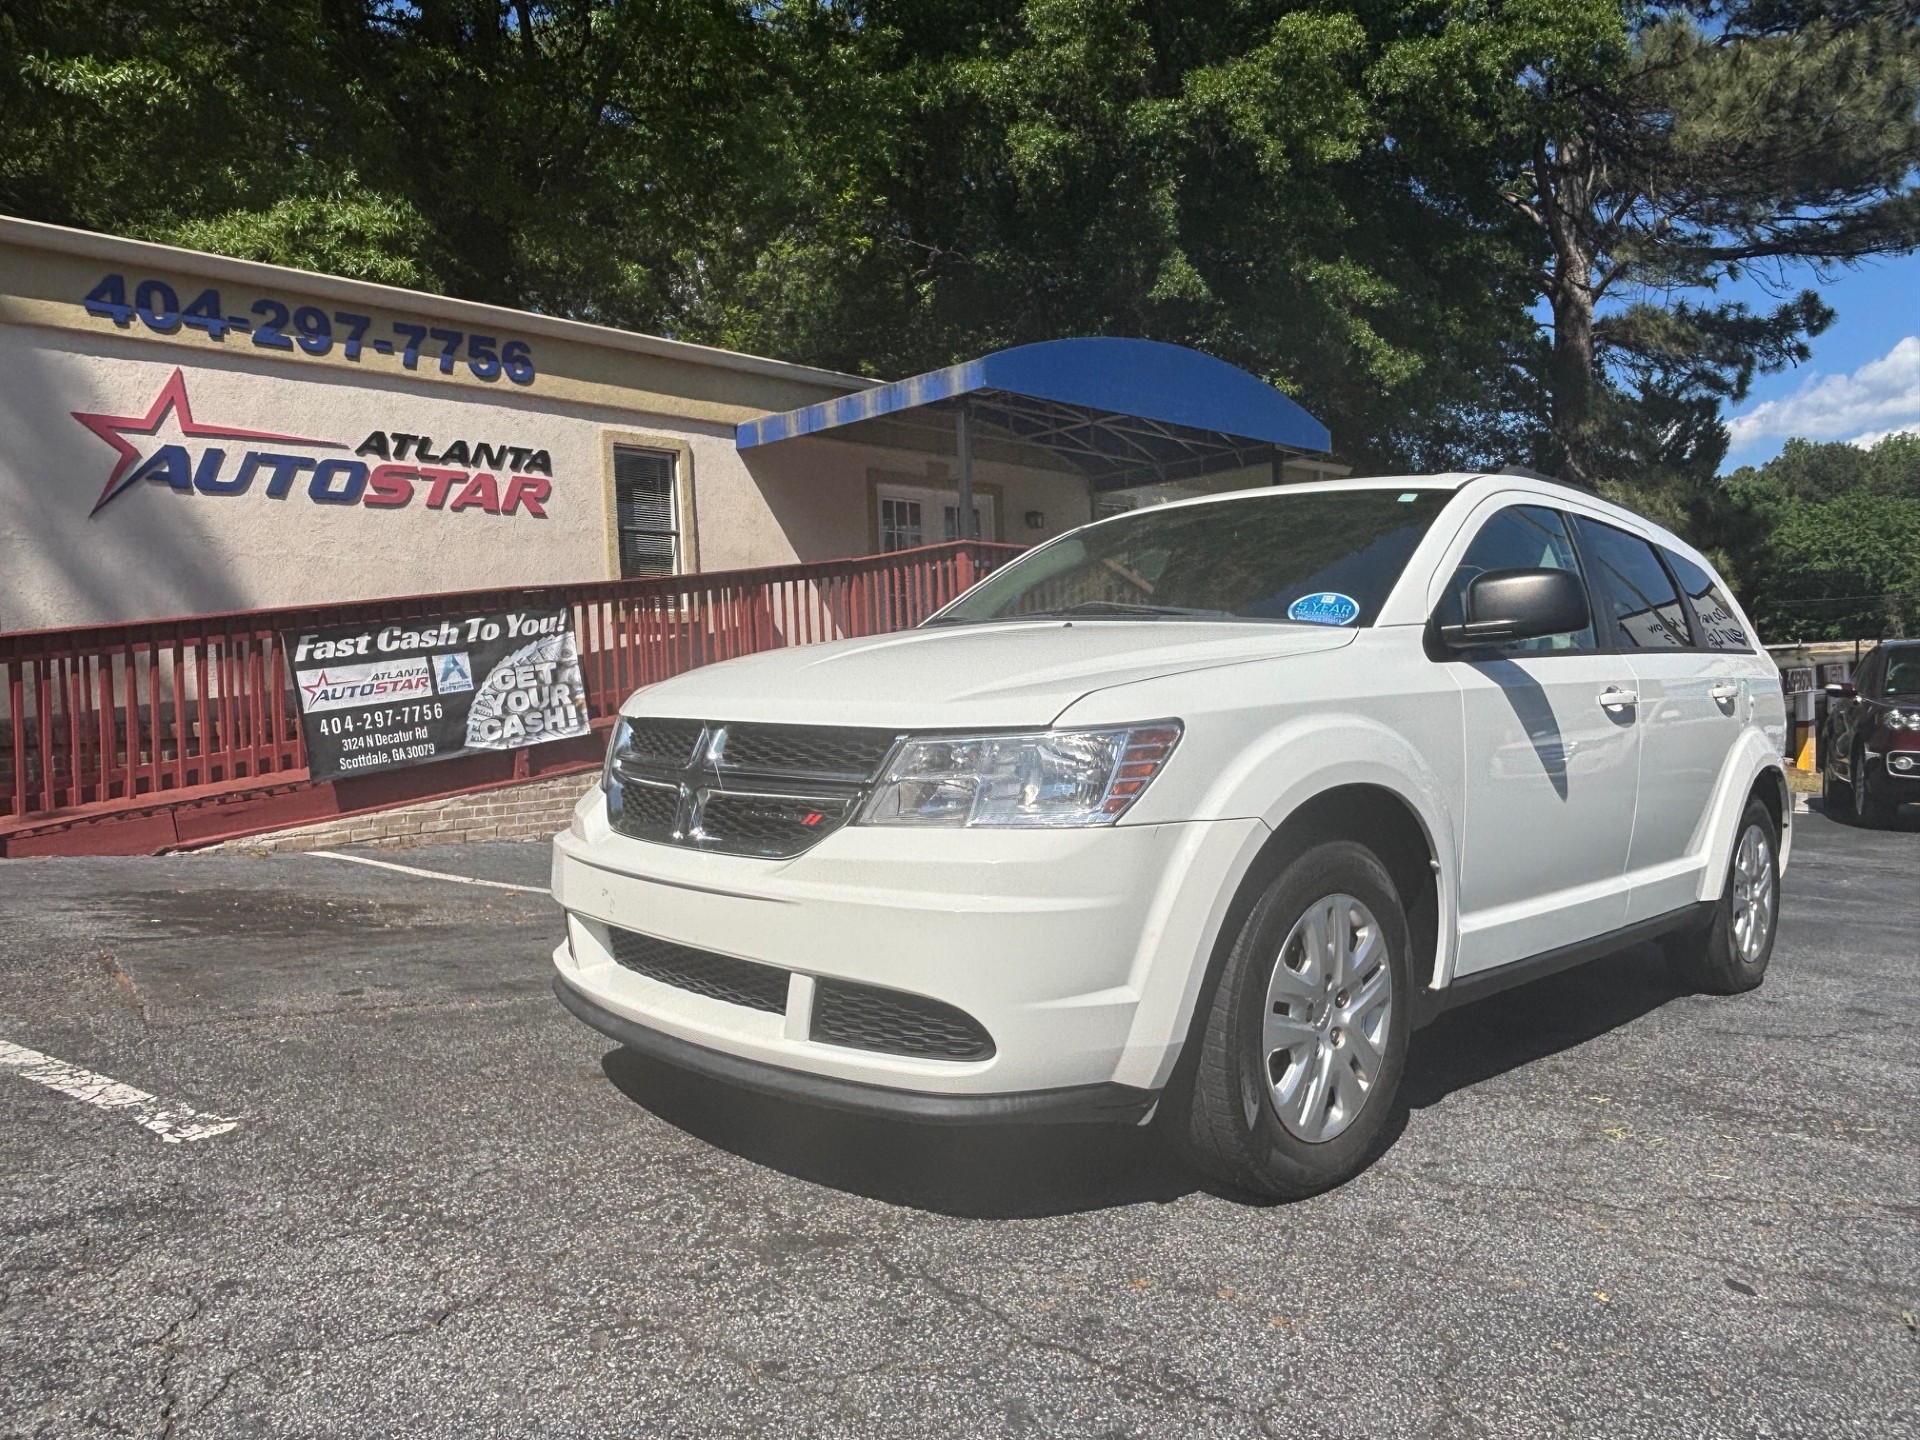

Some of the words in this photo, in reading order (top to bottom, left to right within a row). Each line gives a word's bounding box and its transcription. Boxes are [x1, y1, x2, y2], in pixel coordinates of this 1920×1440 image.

[84, 274, 535, 385] 404-297-7756
[355, 430, 553, 477] ATLANTA
[90, 443, 553, 519] AUTOSTAR
[1296, 602, 1309, 612] 5
[1312, 603, 1352, 614] YEAR
[294, 632, 371, 661] Fast
[377, 621, 459, 652] Cash
[465, 618, 500, 643] To
[506, 607, 567, 638] You!
[371, 667, 428, 682] ATLANTA
[492, 662, 557, 690] GET
[308, 677, 429, 710] AUTOSTAR
[485, 684, 572, 715] YOUR
[320, 703, 443, 735] 404-297-7756
[479, 705, 578, 741] CASH!
[341, 737, 365, 752] 3124
[366, 735, 374, 748] N
[375, 730, 413, 746] Decatur
[415, 726, 428, 739] Rd
[339, 751, 391, 770] Scottdale,
[392, 748, 406, 761] GA
[407, 743, 435, 759] 30079
